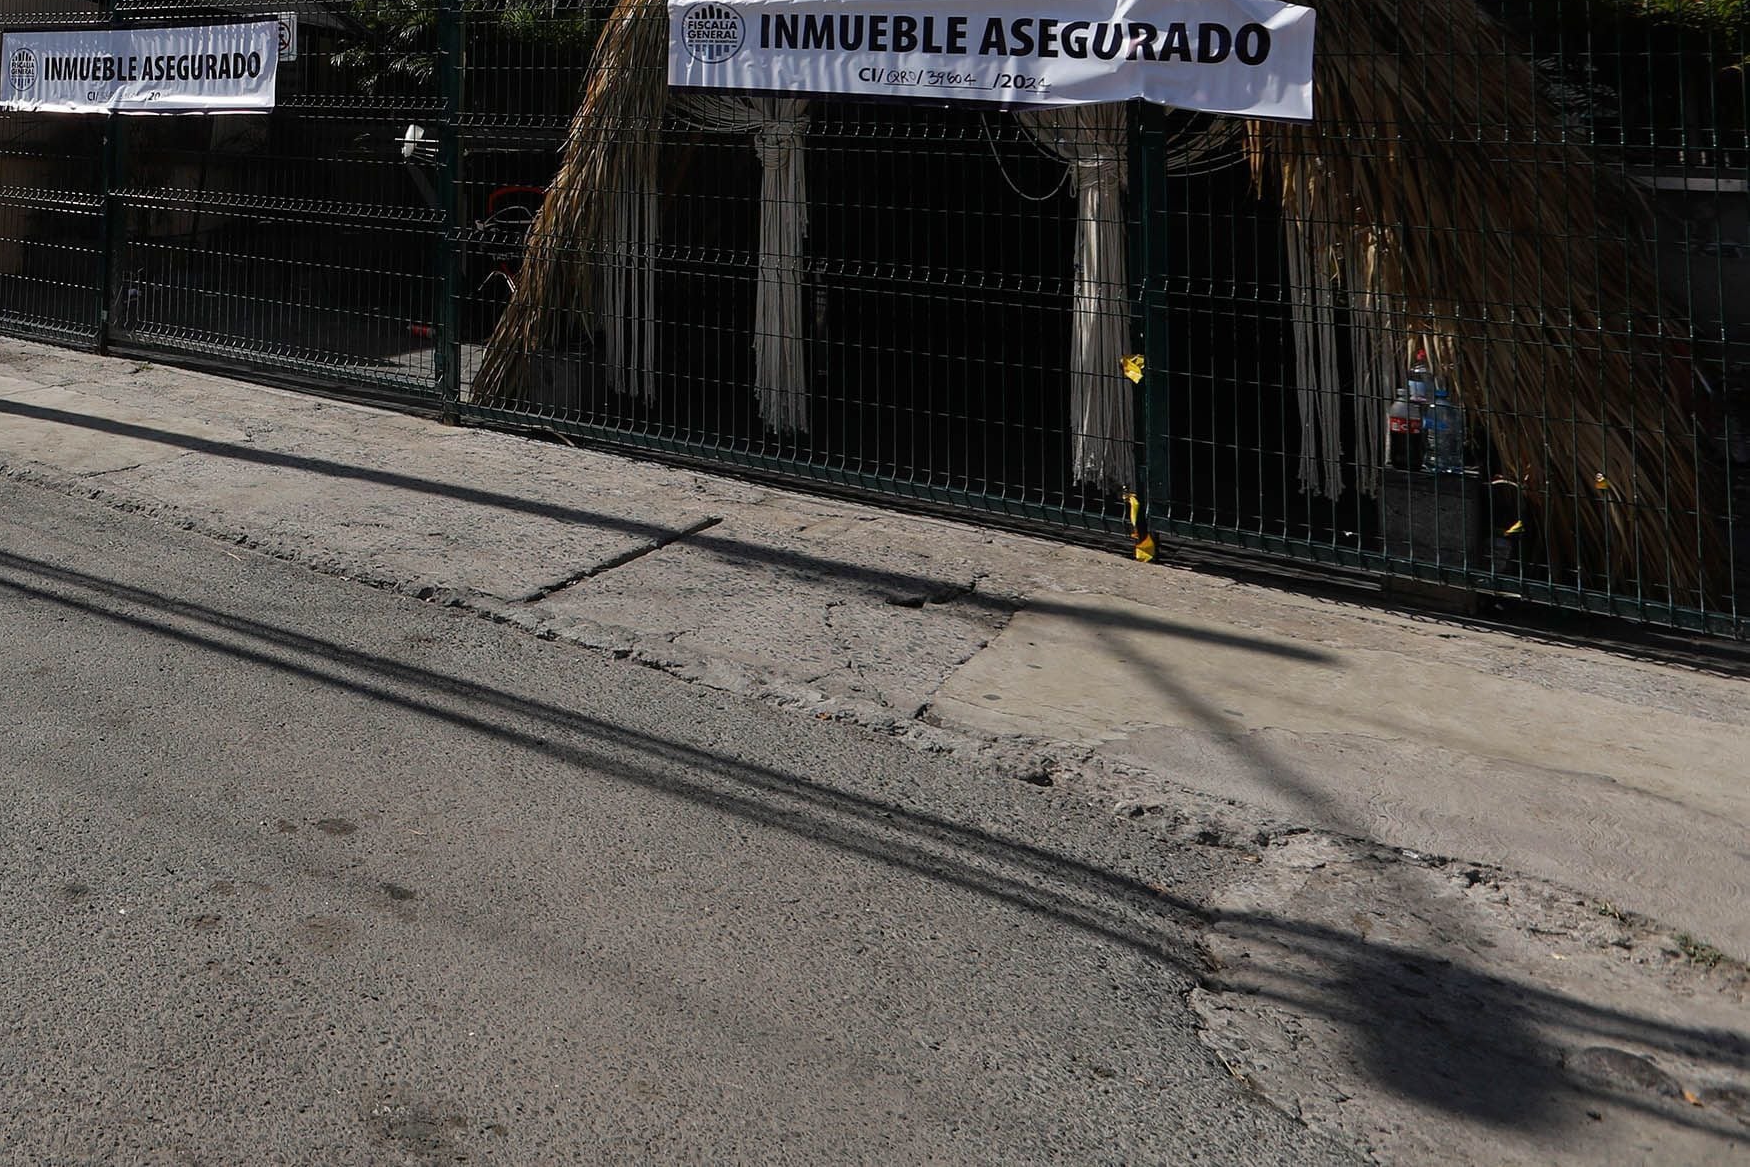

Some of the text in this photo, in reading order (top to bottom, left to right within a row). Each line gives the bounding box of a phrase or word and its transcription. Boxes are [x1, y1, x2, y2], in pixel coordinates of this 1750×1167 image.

[687, 30, 738, 40] GENERAL
[760, 13, 1272, 66] INMUEBLE ASEGURADO
[44, 51, 261, 82] INMUEBLE ASEGURADO
